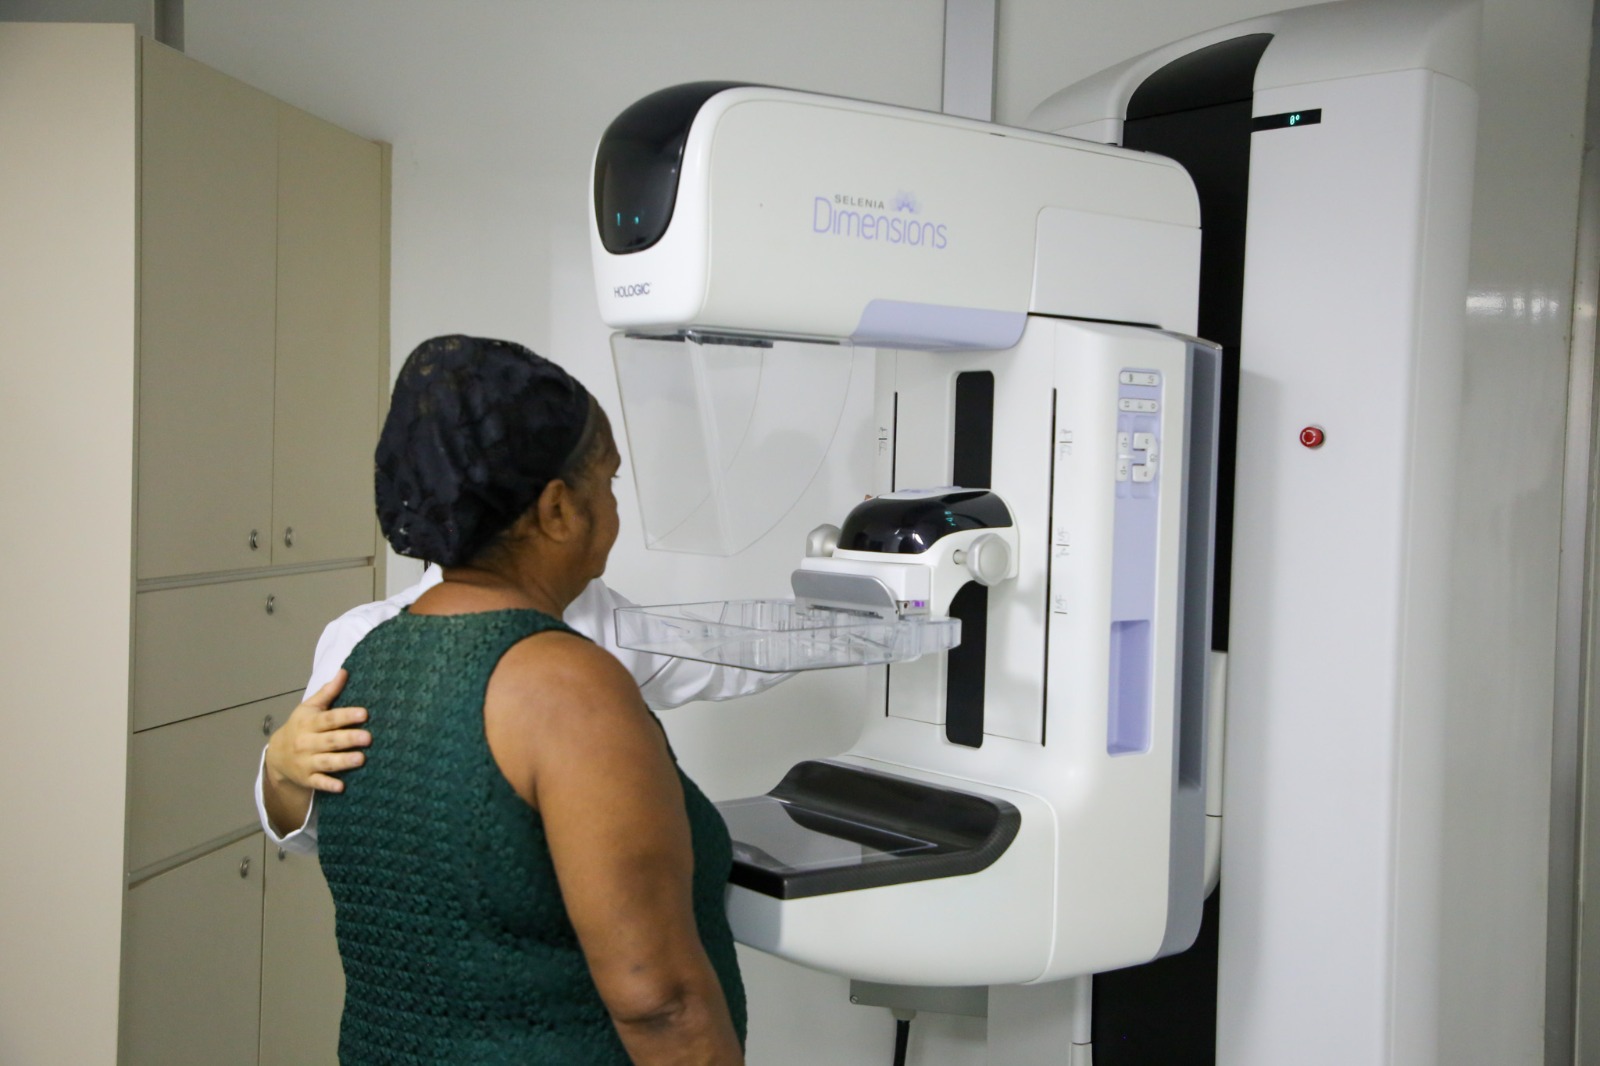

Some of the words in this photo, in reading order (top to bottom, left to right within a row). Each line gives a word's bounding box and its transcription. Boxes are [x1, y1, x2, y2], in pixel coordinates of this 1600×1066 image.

[834, 194, 885, 210] SELENIA
[813, 196, 947, 249] Dimensions
[614, 282, 651, 298] HOLOGIC
